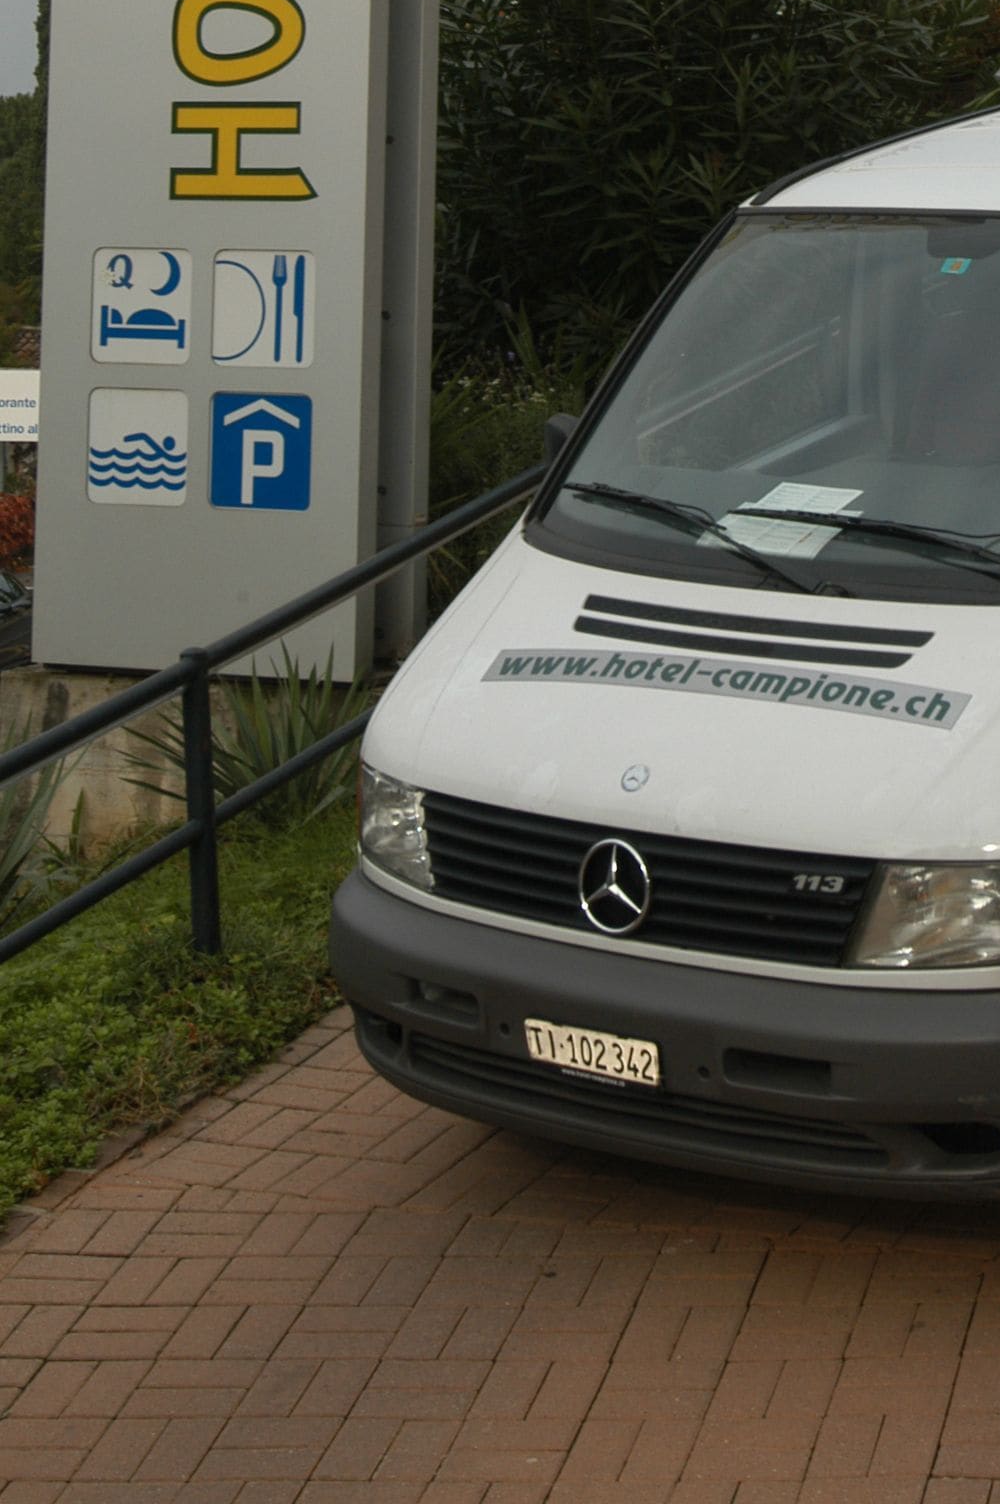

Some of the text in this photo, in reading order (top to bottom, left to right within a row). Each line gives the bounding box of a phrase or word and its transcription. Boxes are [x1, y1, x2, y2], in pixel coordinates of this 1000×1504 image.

[240, 428, 285, 505] P
[499, 652, 953, 722] www.hotel-campione.ch
[793, 874, 844, 893] 113
